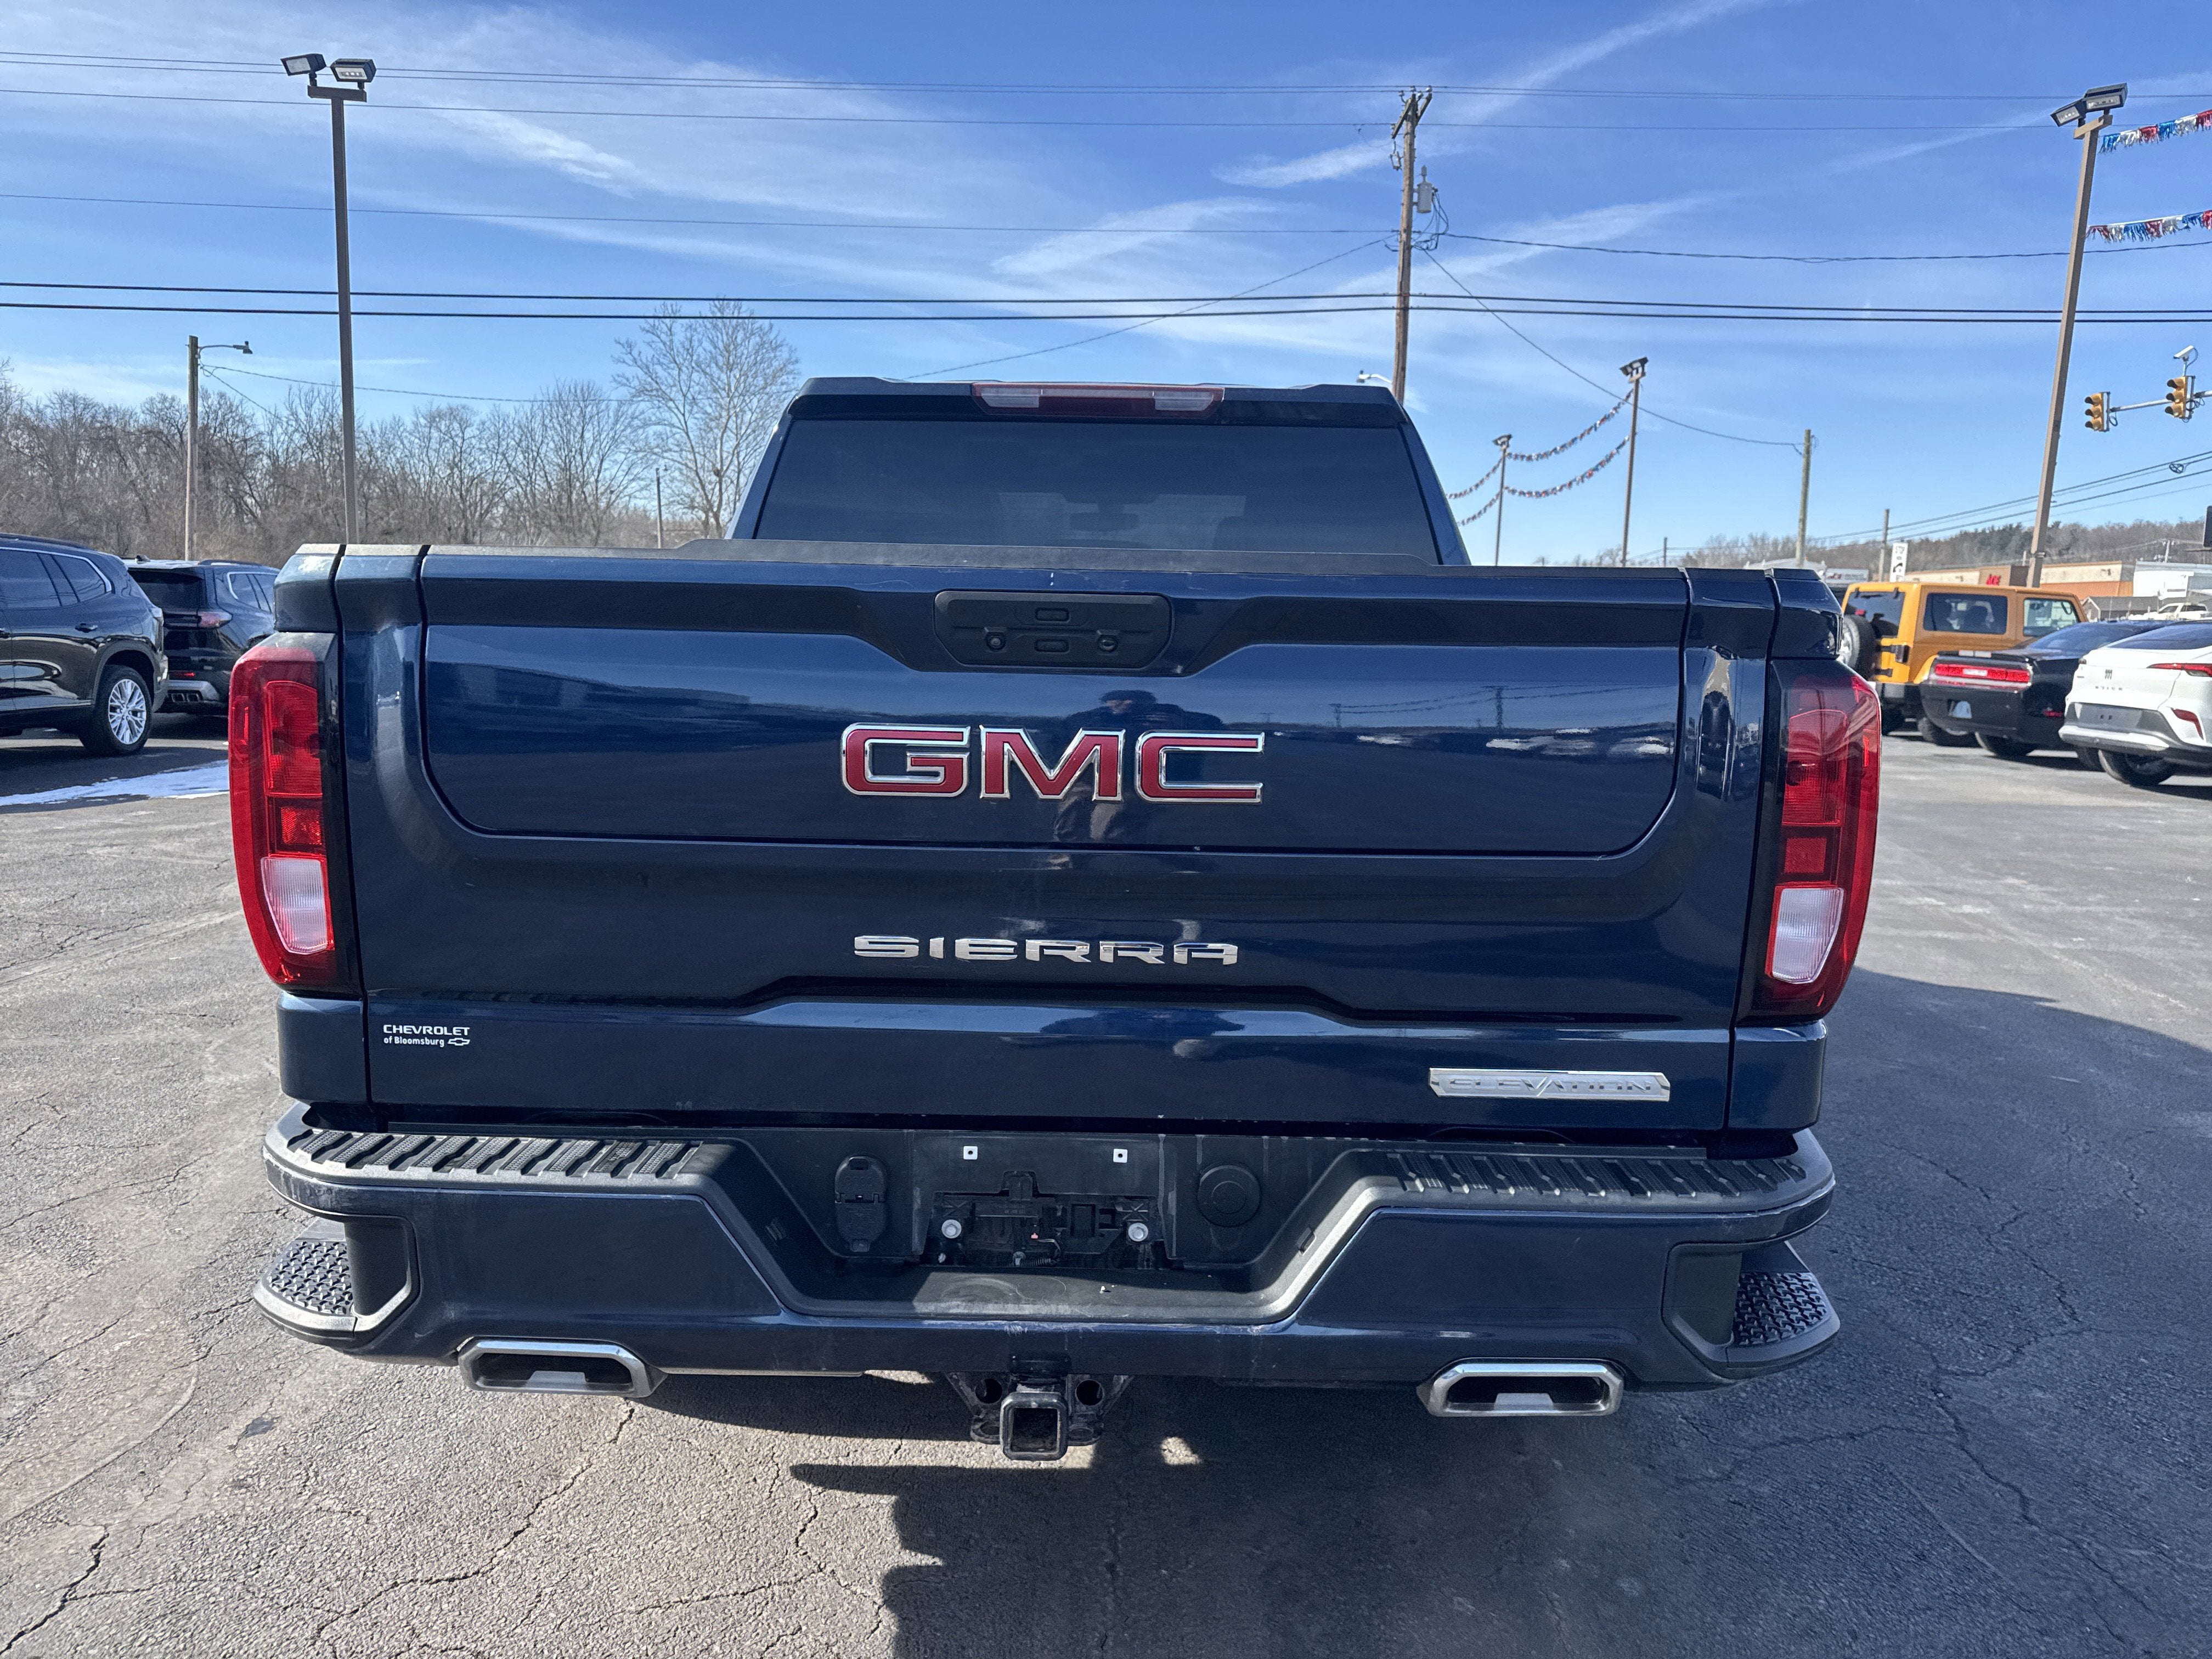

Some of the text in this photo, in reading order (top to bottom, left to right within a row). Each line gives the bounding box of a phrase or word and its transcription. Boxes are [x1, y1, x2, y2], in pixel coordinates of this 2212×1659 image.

[841, 723, 1265, 803] GMC
[854, 935, 1239, 966] SIERRA
[383, 1024, 470, 1036] CHEVROLET
[383, 1036, 444, 1047] of Bloomsburg
[1449, 1076, 1652, 1091] ELEVATION
